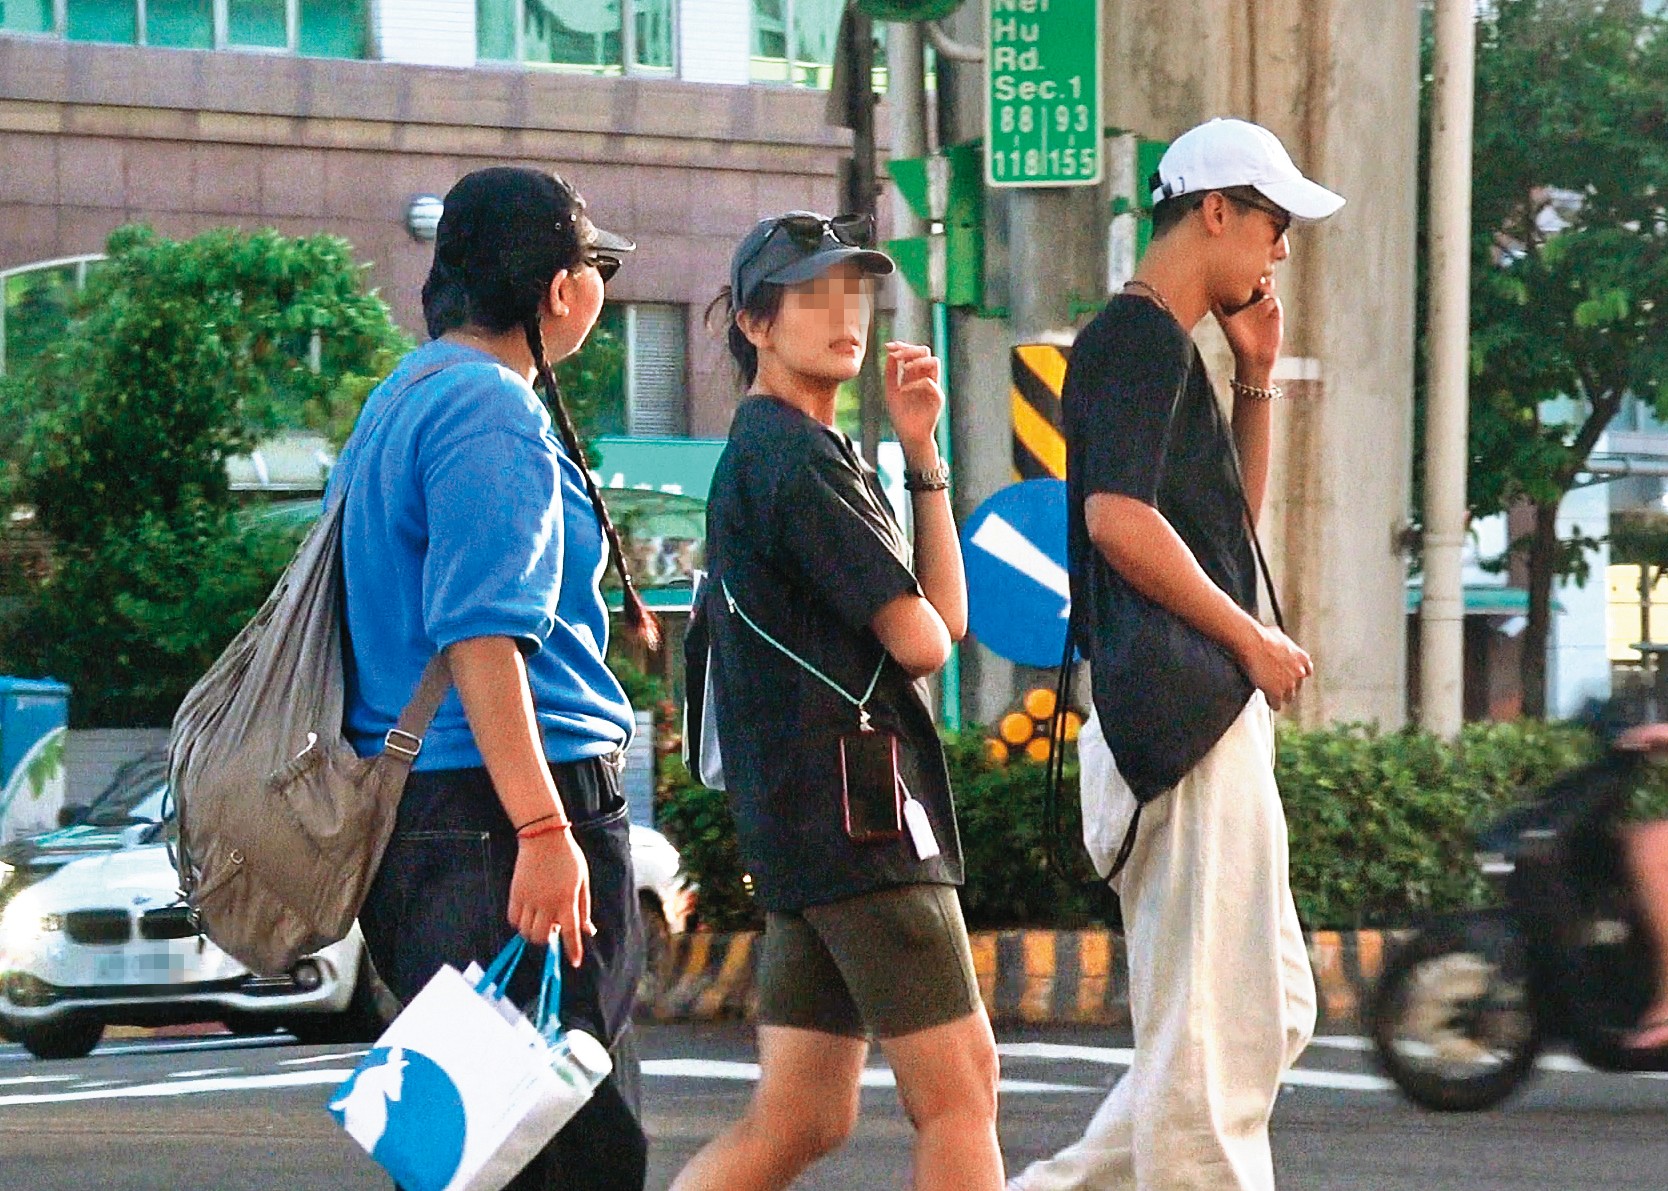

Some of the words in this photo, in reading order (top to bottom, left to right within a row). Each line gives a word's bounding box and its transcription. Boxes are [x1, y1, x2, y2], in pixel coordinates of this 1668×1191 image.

[993, 17, 1040, 42] Hu
[993, 47, 1045, 71] Rd.
[1055, 104, 1089, 132] 93
[1048, 148, 1095, 176] 155
